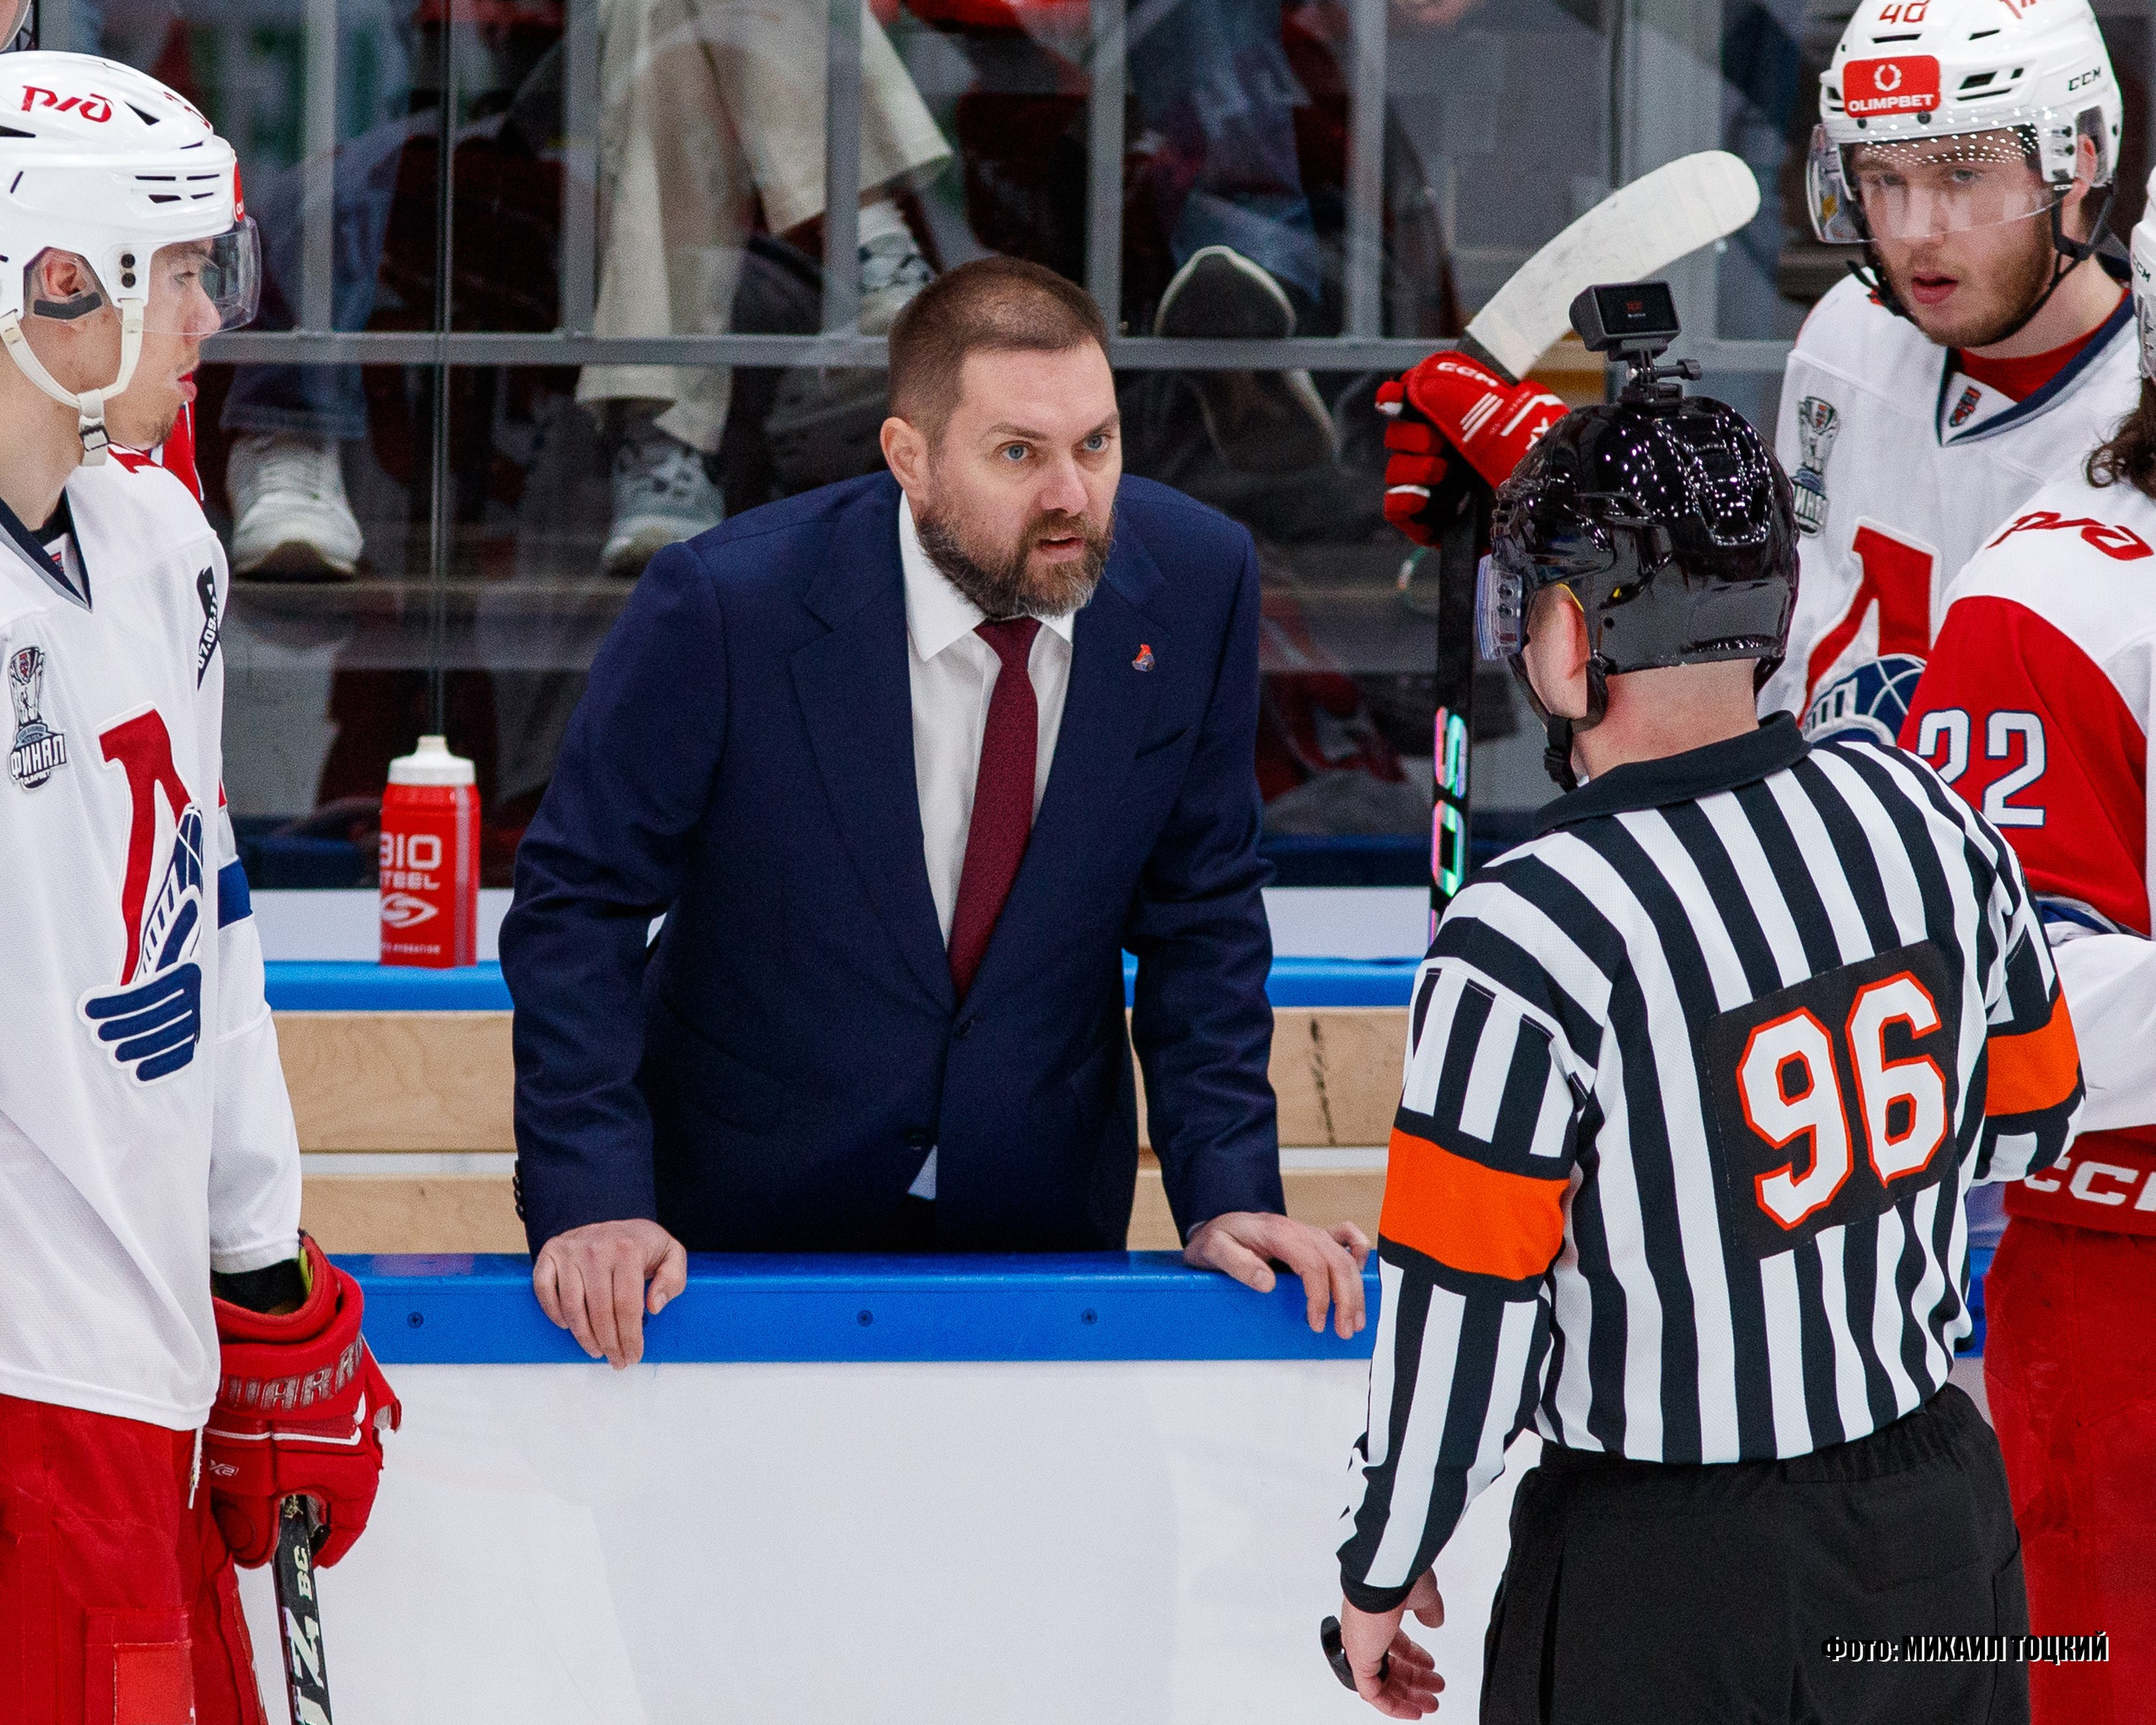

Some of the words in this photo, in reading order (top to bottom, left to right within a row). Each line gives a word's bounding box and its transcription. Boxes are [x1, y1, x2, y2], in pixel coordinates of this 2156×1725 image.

[2068, 65, 2101, 91] CCM
[1848, 93, 1935, 112] OLIMPBET
[10, 734, 67, 780] ФИНАЛ
[1917, 706, 2047, 828] 22
[381, 870, 440, 891] TEEL
[1737, 970, 1948, 1231] 96
